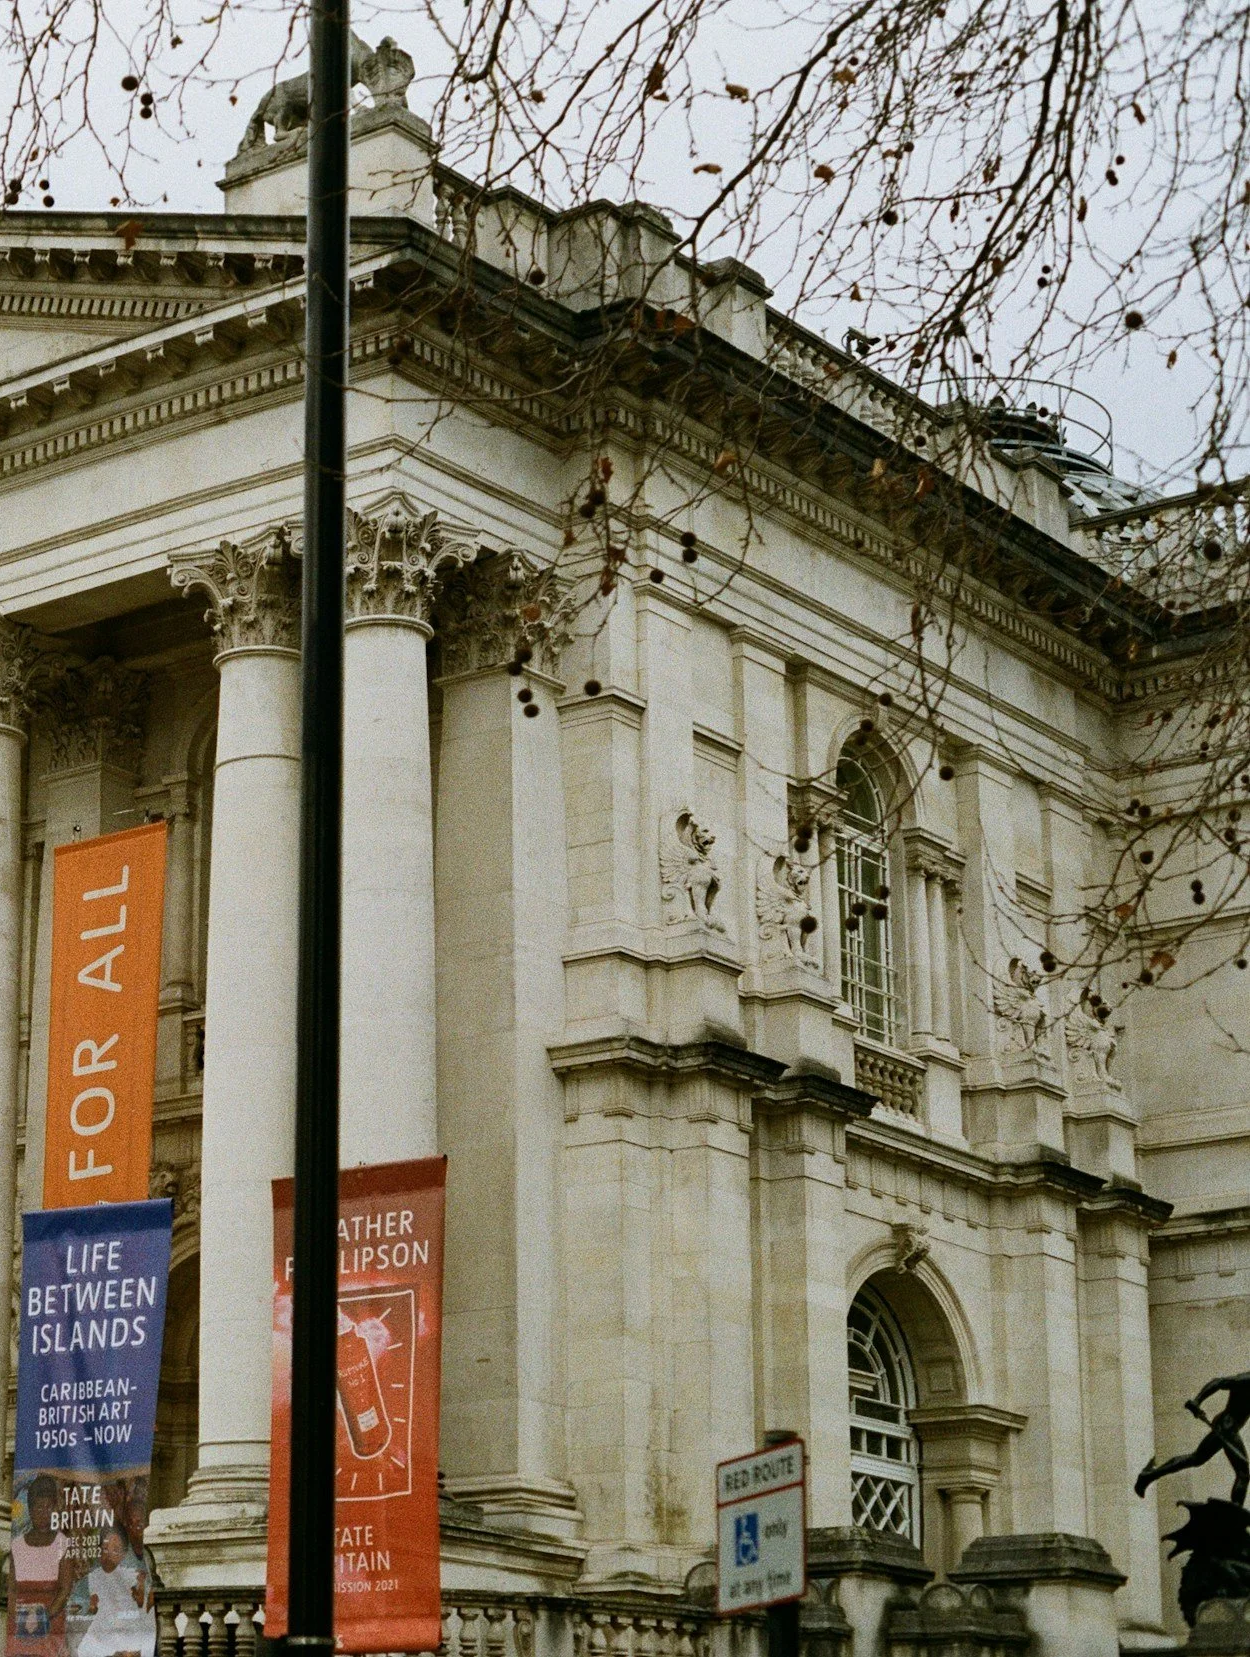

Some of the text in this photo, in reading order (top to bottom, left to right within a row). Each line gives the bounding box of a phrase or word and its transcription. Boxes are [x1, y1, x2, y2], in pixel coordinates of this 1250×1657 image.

[68, 864, 130, 1181] FOR ALL
[338, 1210, 414, 1243] ATHER
[66, 1241, 122, 1275] LIFE
[285, 1240, 430, 1282] PLIPSON
[27, 1276, 157, 1317] BETWEEN
[32, 1316, 146, 1355] ISLANDS
[40, 1378, 137, 1403] CARIBBEAN-
[38, 1401, 132, 1426] BRITISH ART
[35, 1431, 77, 1450] 1950s
[725, 1455, 794, 1491] RED ROUTE
[64, 1486, 101, 1505] TATE
[51, 1509, 114, 1530] BRITAIN
[764, 1518, 788, 1540] only
[65, 1548, 81, 1560] APR
[82, 1547, 102, 1558] 2022
[66, 1536, 80, 1548] DEC
[82, 1535, 100, 1546] 2021
[334, 1550, 391, 1574] ITAIN
[375, 1579, 399, 1592] 2021
